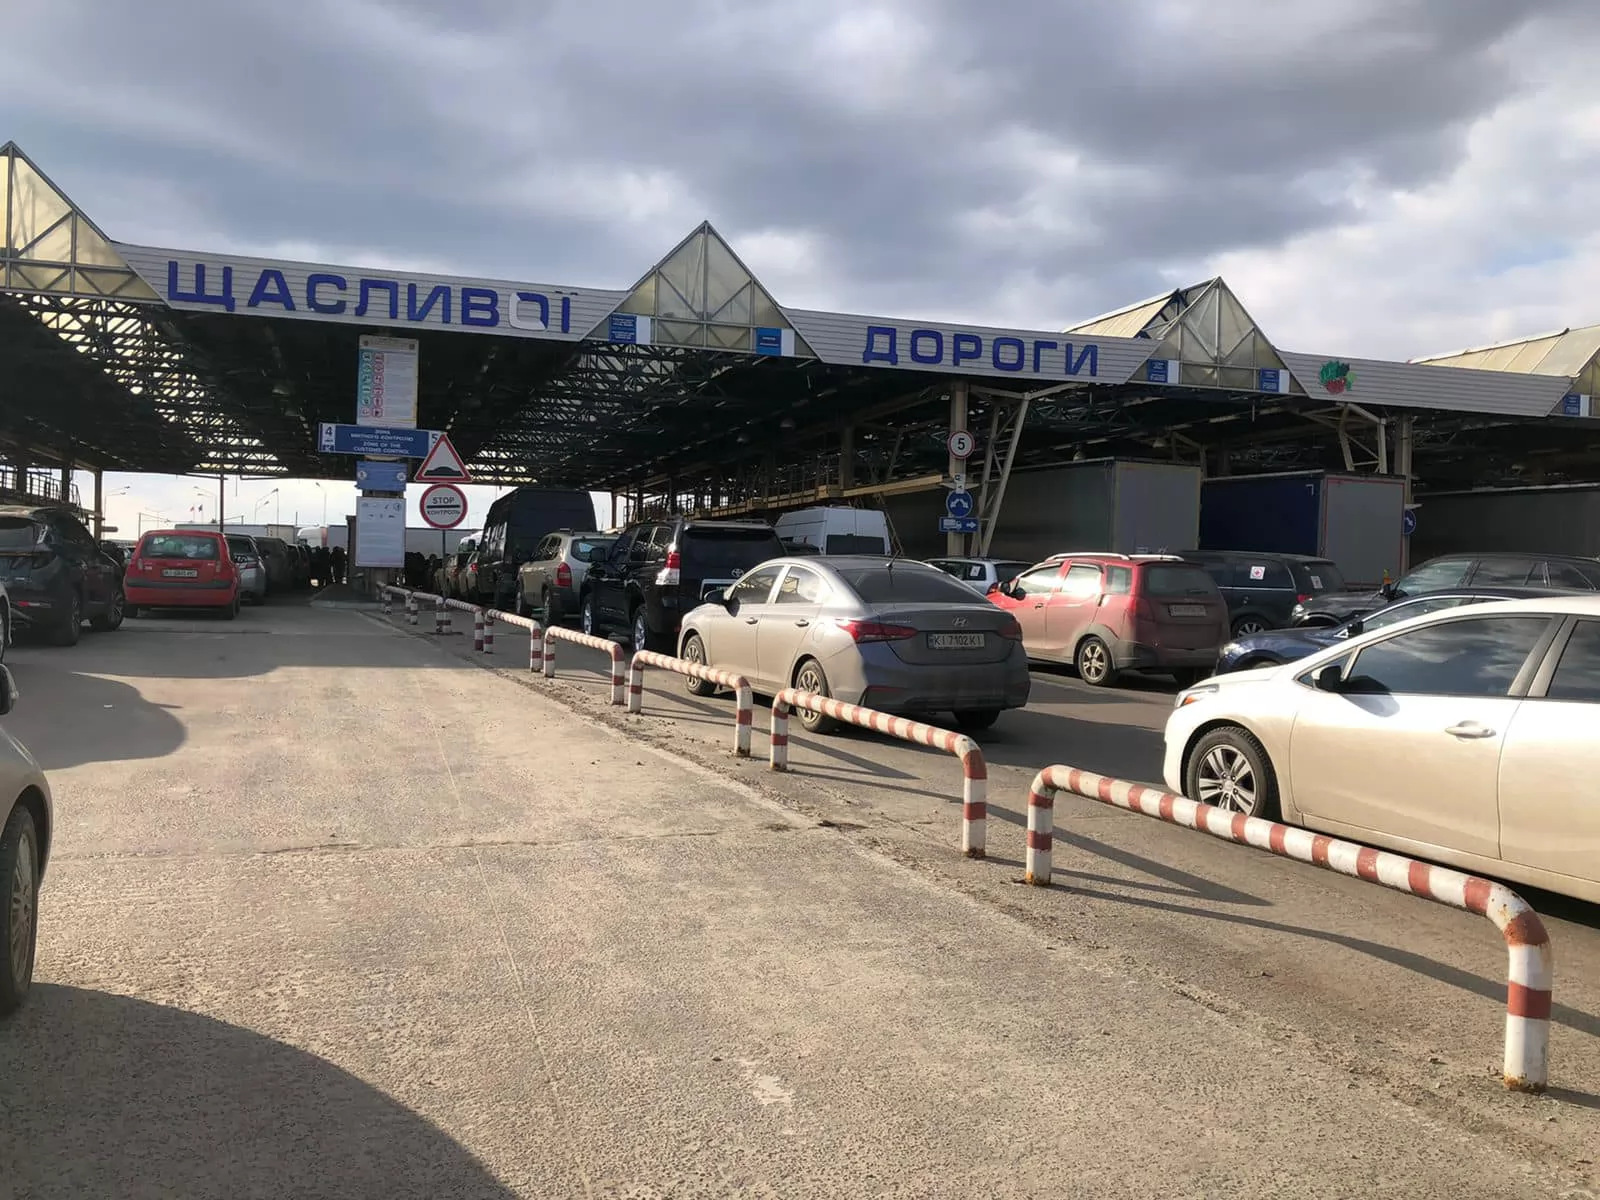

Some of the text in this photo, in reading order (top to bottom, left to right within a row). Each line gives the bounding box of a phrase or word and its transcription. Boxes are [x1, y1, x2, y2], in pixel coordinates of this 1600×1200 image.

[862, 325, 1098, 377] ДОРОГИ
[325, 426, 333, 436] 4
[957, 437, 966, 451] 5
[432, 496, 455, 505] STOP
